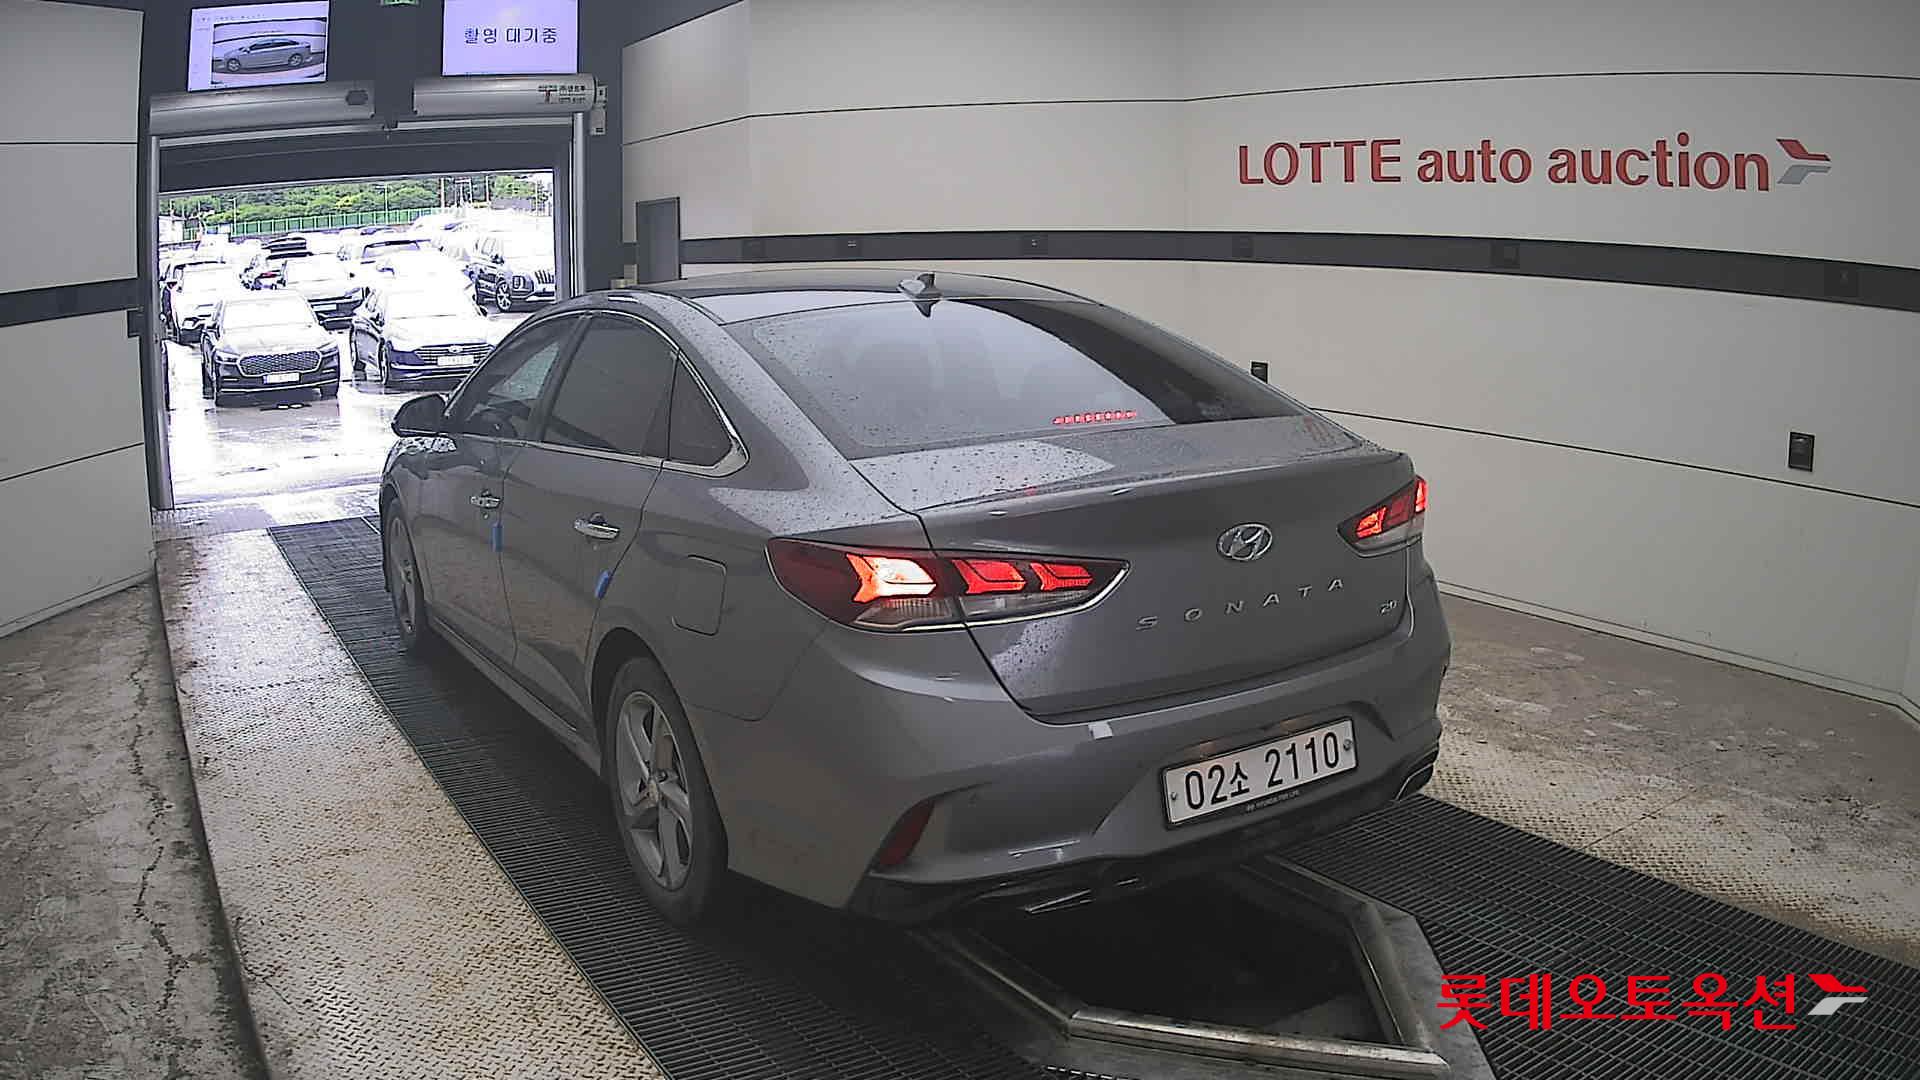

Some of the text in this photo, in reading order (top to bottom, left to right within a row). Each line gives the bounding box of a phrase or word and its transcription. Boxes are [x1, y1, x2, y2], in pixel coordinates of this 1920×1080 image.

[464, 27, 558, 44] 촬영 대기중
[1238, 131, 1770, 192] LOTTE auto auction
[1135, 578, 1344, 631] SONATA
[1184, 764, 1251, 810] 02소
[1264, 731, 1340, 789] 2110
